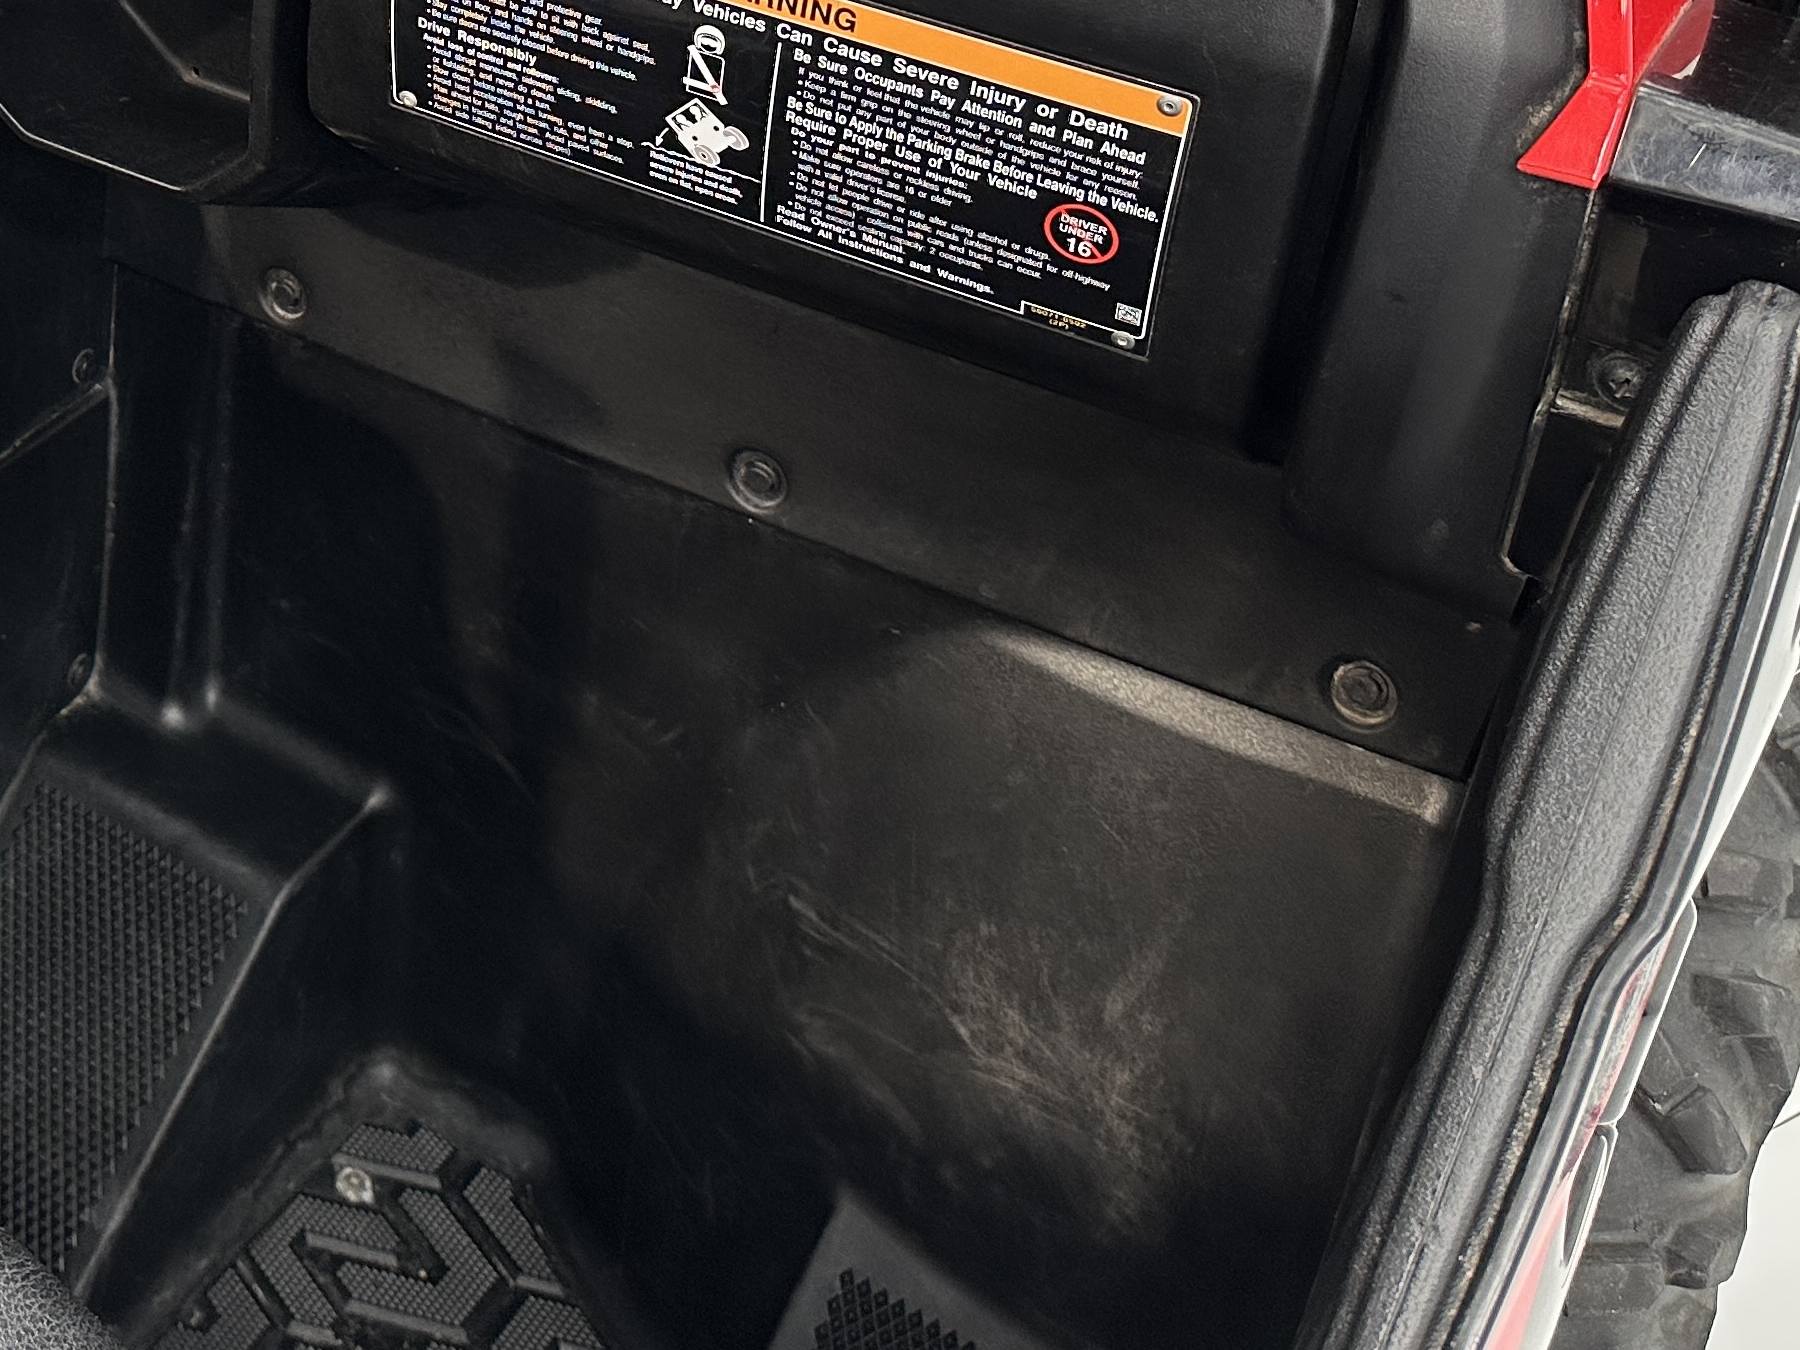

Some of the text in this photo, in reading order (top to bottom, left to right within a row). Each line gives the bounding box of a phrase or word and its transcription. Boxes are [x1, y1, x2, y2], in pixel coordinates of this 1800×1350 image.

[417, 16, 537, 67] Drive Responsibly
[774, 22, 813, 47] Can
[823, 36, 883, 67] Cause
[892, 57, 960, 91] Severe
[969, 80, 1027, 113] Injury
[1034, 103, 1060, 120] or
[1067, 109, 1129, 141] Death
[792, 47, 1147, 166] Be Sure Occupants Pay Attention and Plan Ahead
[785, 109, 1038, 200] Require Proper Use of Your Vehicle
[786, 95, 1159, 223] Be Sure to Apply the Parking Brake Before Leaving the Vehicle.
[790, 126, 807, 138] Do
[810, 134, 835, 147] your
[838, 143, 860, 156] part
[864, 150, 876, 160] to
[878, 156, 921, 175] prevent
[776, 204, 907, 255] Read Owner's Manual.
[1058, 211, 1108, 236] DRIVER
[1058, 222, 1104, 245] UNDER
[1066, 237, 1095, 257] 16
[776, 214, 995, 295] Follow All Instructions and Warnings.
